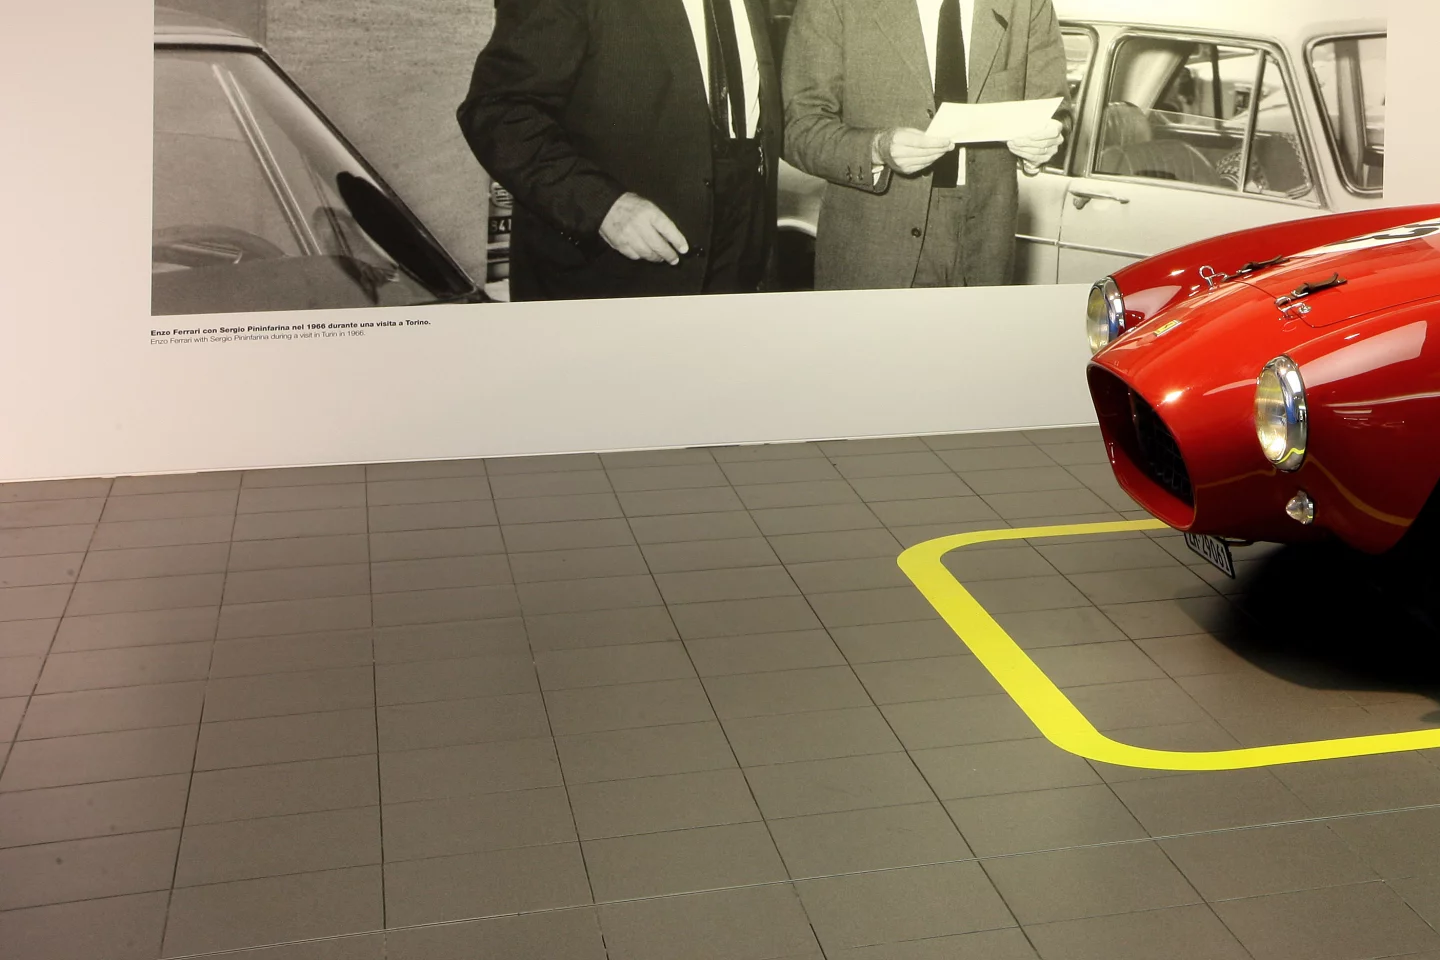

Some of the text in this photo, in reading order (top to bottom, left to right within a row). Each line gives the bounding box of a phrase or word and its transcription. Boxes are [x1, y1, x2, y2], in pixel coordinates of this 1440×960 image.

[151, 329, 170, 337] Enzo
[173, 328, 200, 336] Ferrari
[219, 326, 245, 335] Sergio
[247, 325, 290, 333] Pininfarina
[210, 335, 232, 343] Sergio
